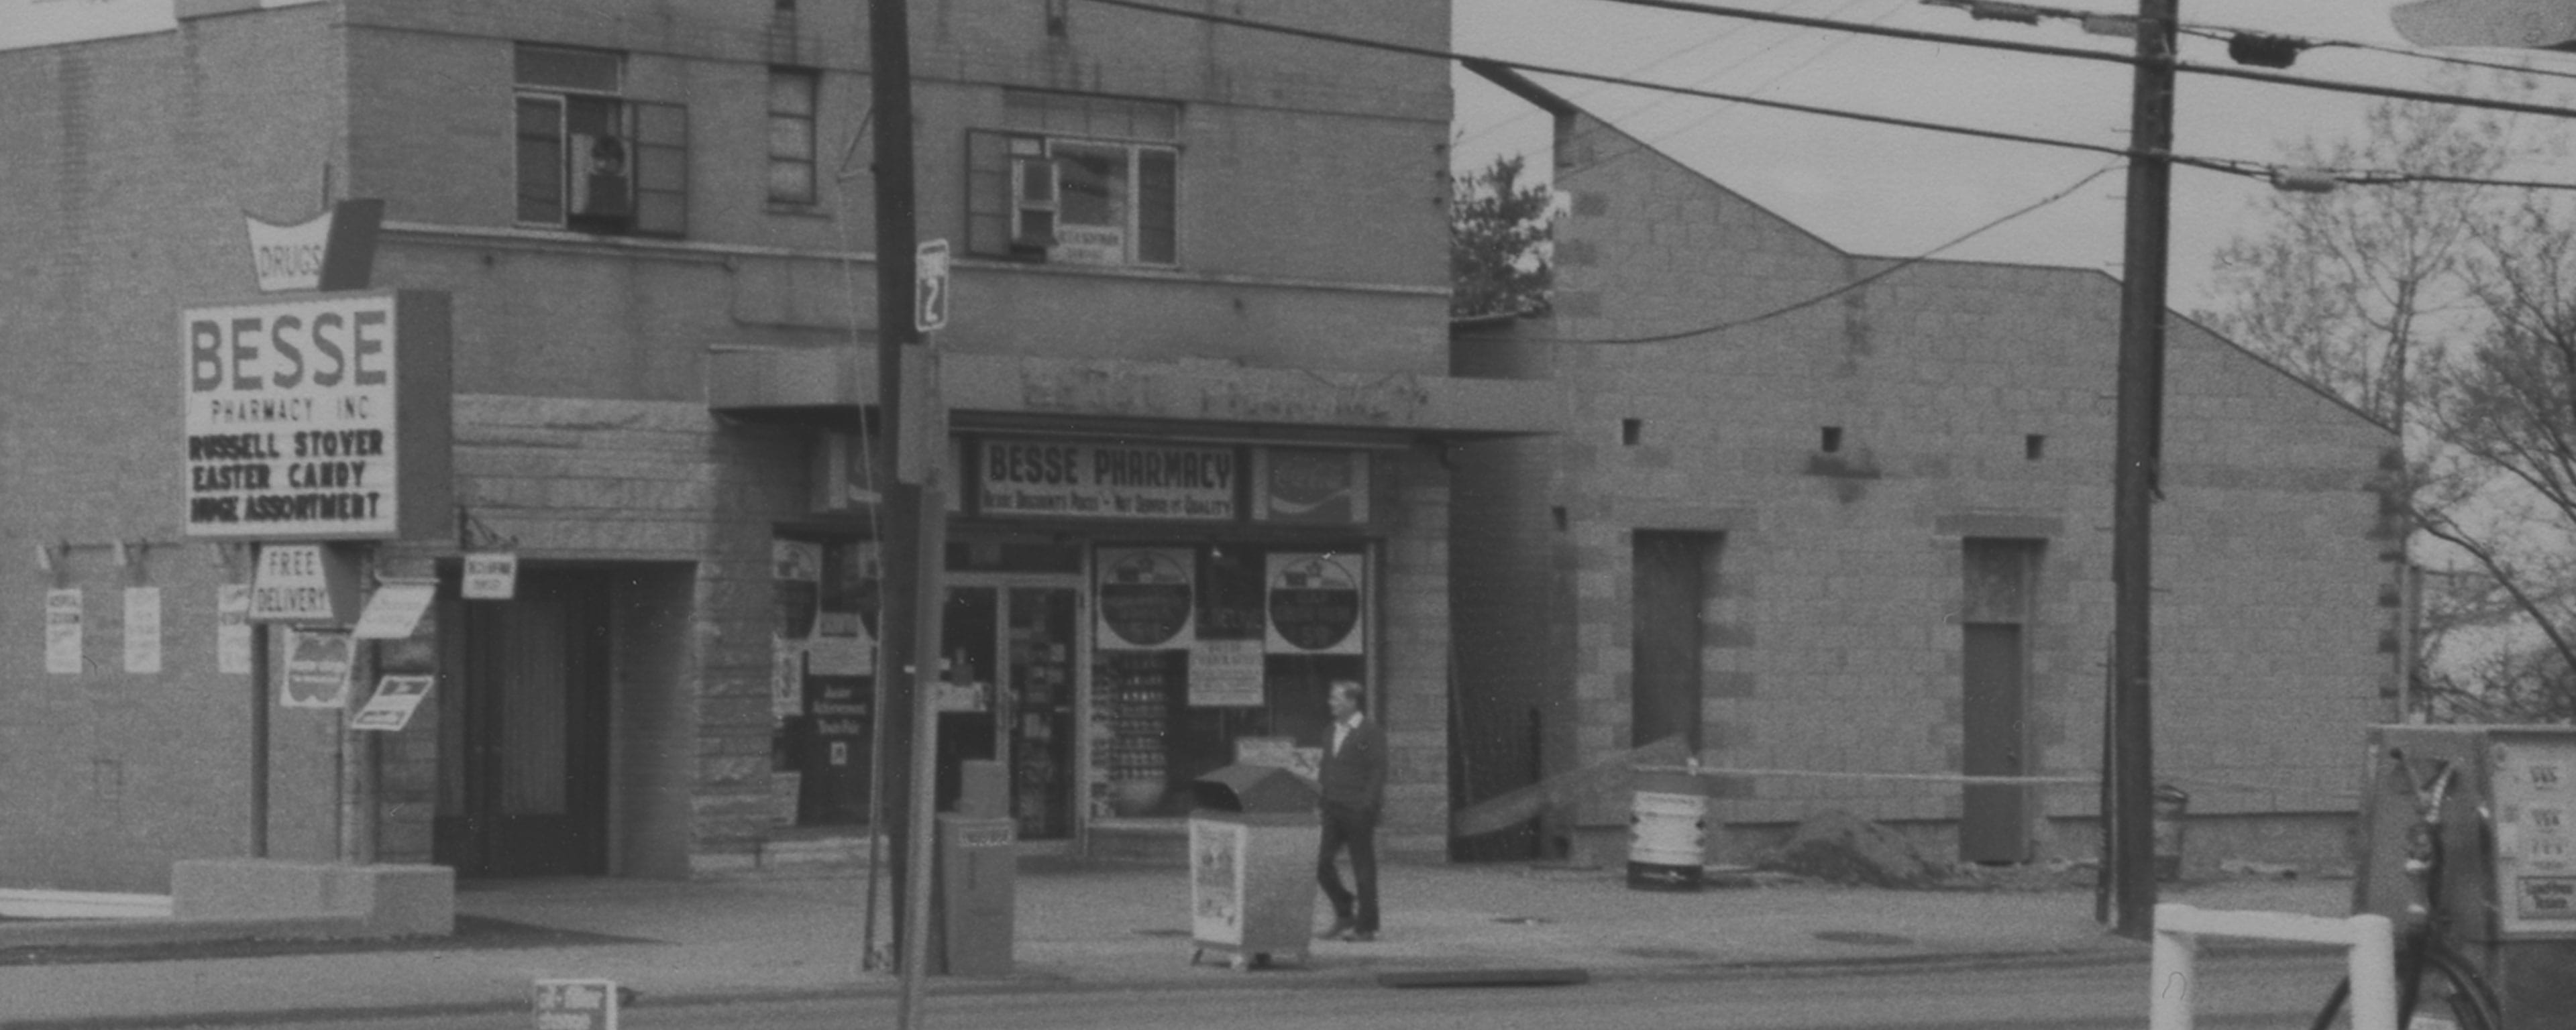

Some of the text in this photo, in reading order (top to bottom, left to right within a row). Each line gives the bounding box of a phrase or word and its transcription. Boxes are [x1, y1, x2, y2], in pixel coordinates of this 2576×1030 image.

[260, 245, 323, 276] DRUGS
[191, 310, 387, 392] BESSE
[211, 398, 313, 422] PHARMACY
[189, 429, 384, 461] RUSSELL STOVER
[193, 461, 366, 492] EASTER CANDY
[989, 445, 1078, 484] BESSE
[1093, 448, 1231, 489] PHARMACY
[244, 492, 380, 522] ASSORTMENT
[270, 551, 314, 576] FREE
[258, 587, 325, 613] DELIVERY
